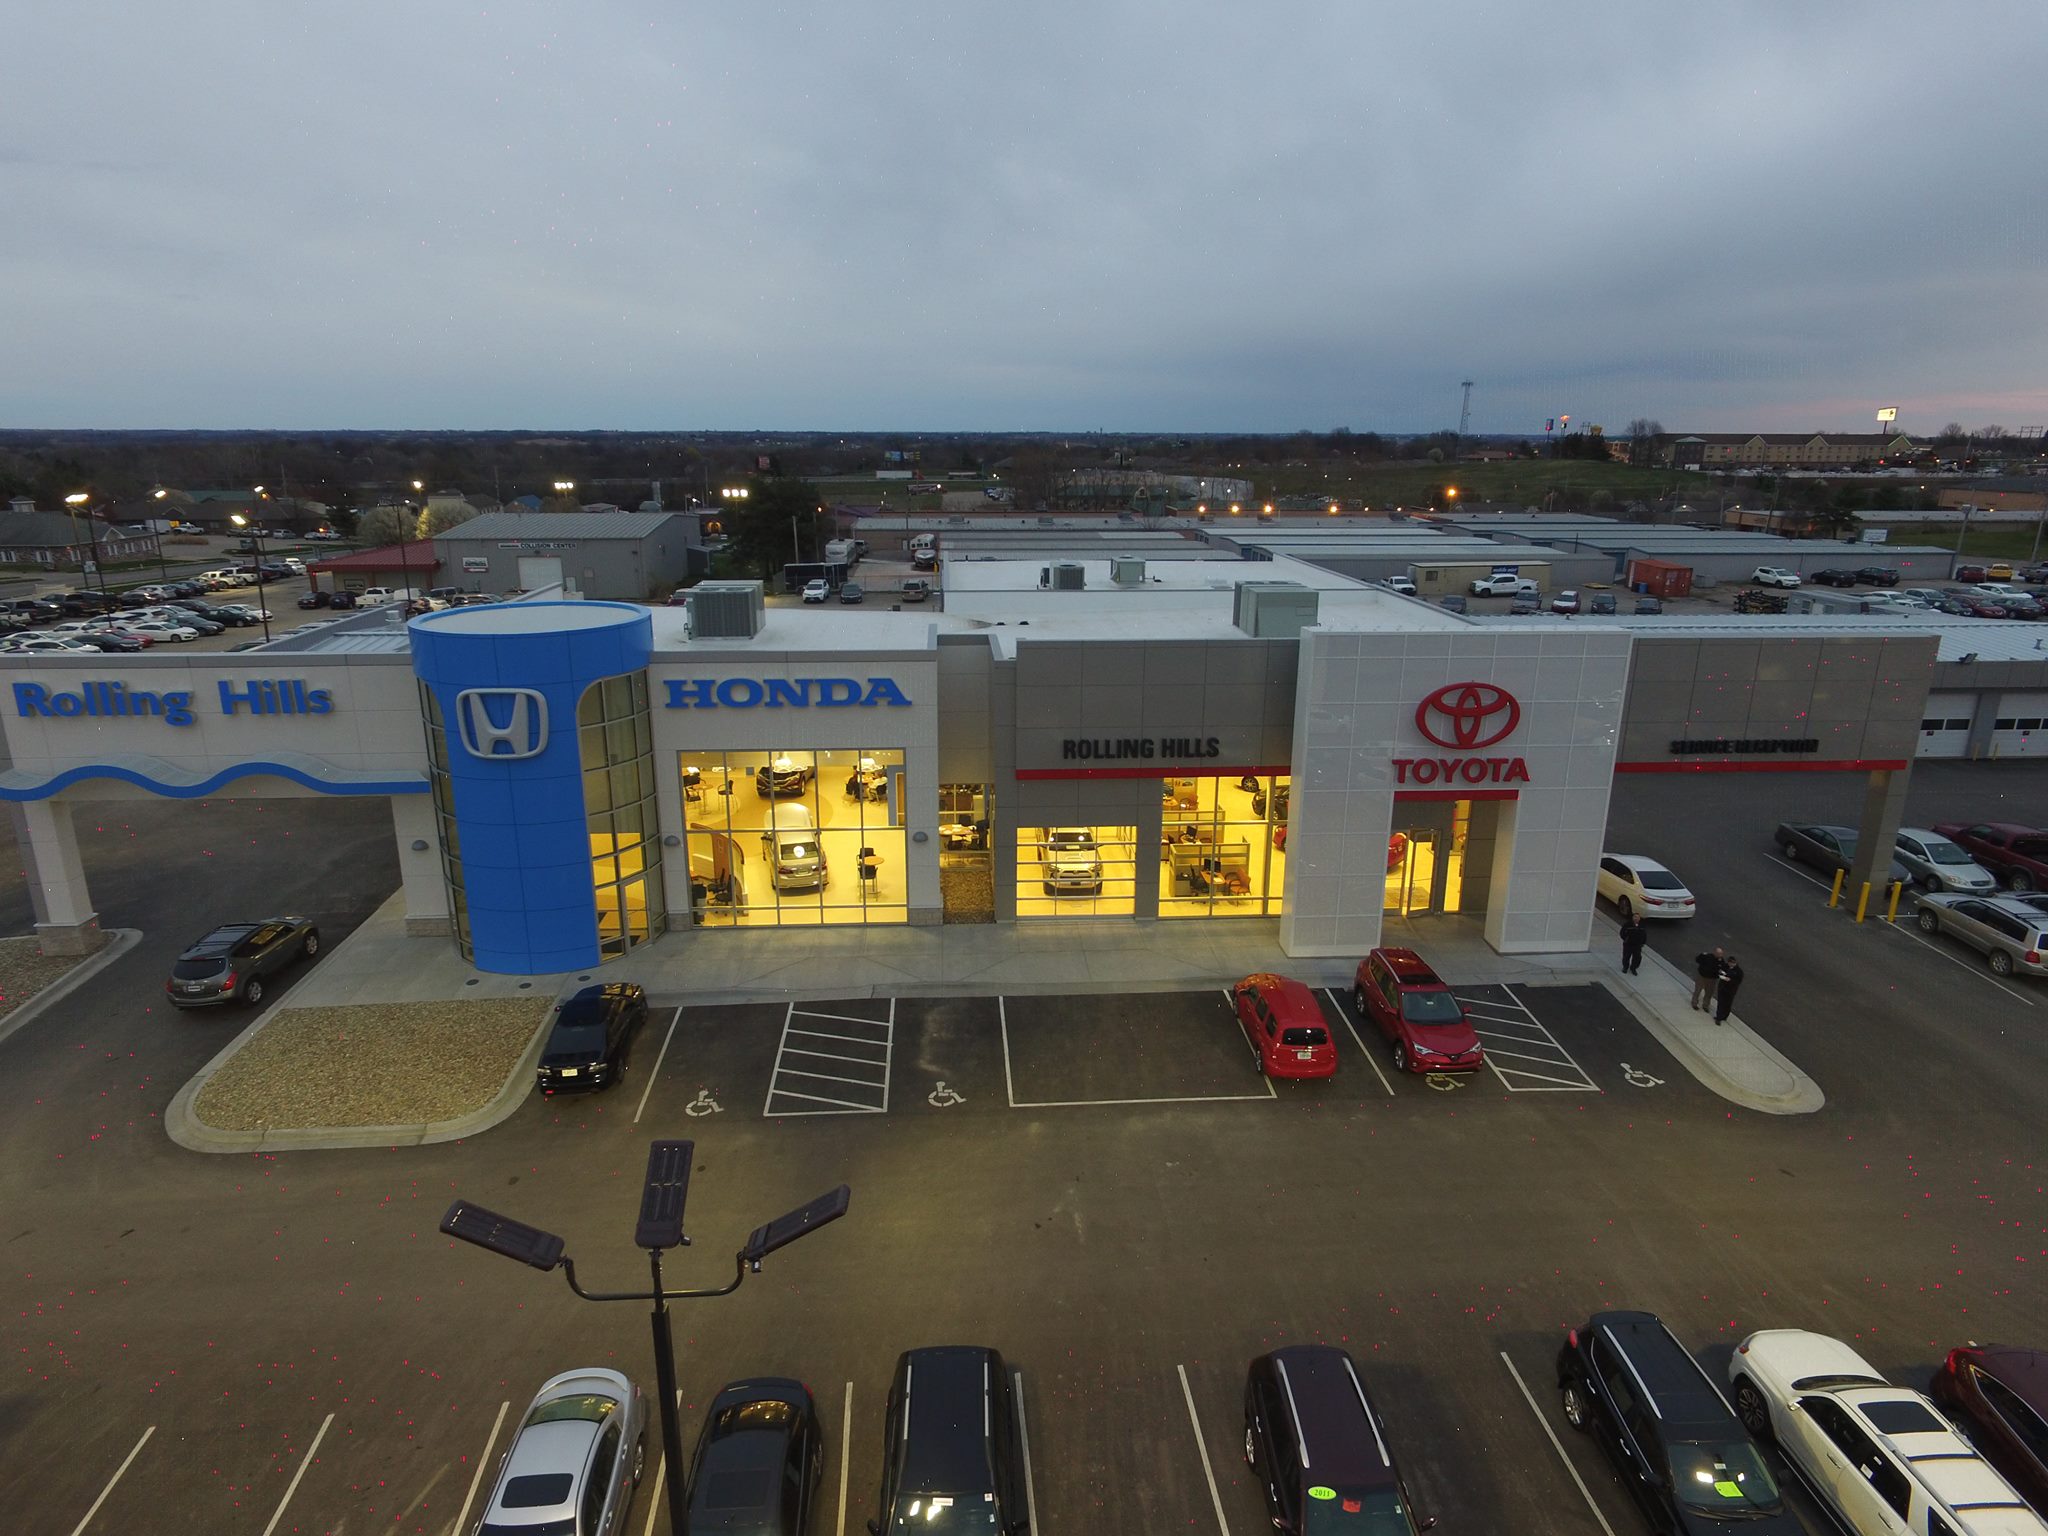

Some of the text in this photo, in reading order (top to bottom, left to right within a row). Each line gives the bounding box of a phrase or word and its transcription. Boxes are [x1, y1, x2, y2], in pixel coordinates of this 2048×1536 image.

[12, 679, 333, 726] Rolling Hills
[663, 678, 912, 708] HONDA
[1063, 737, 1220, 760] ROLLING HILLS
[1392, 757, 1530, 784] TOYOTA
